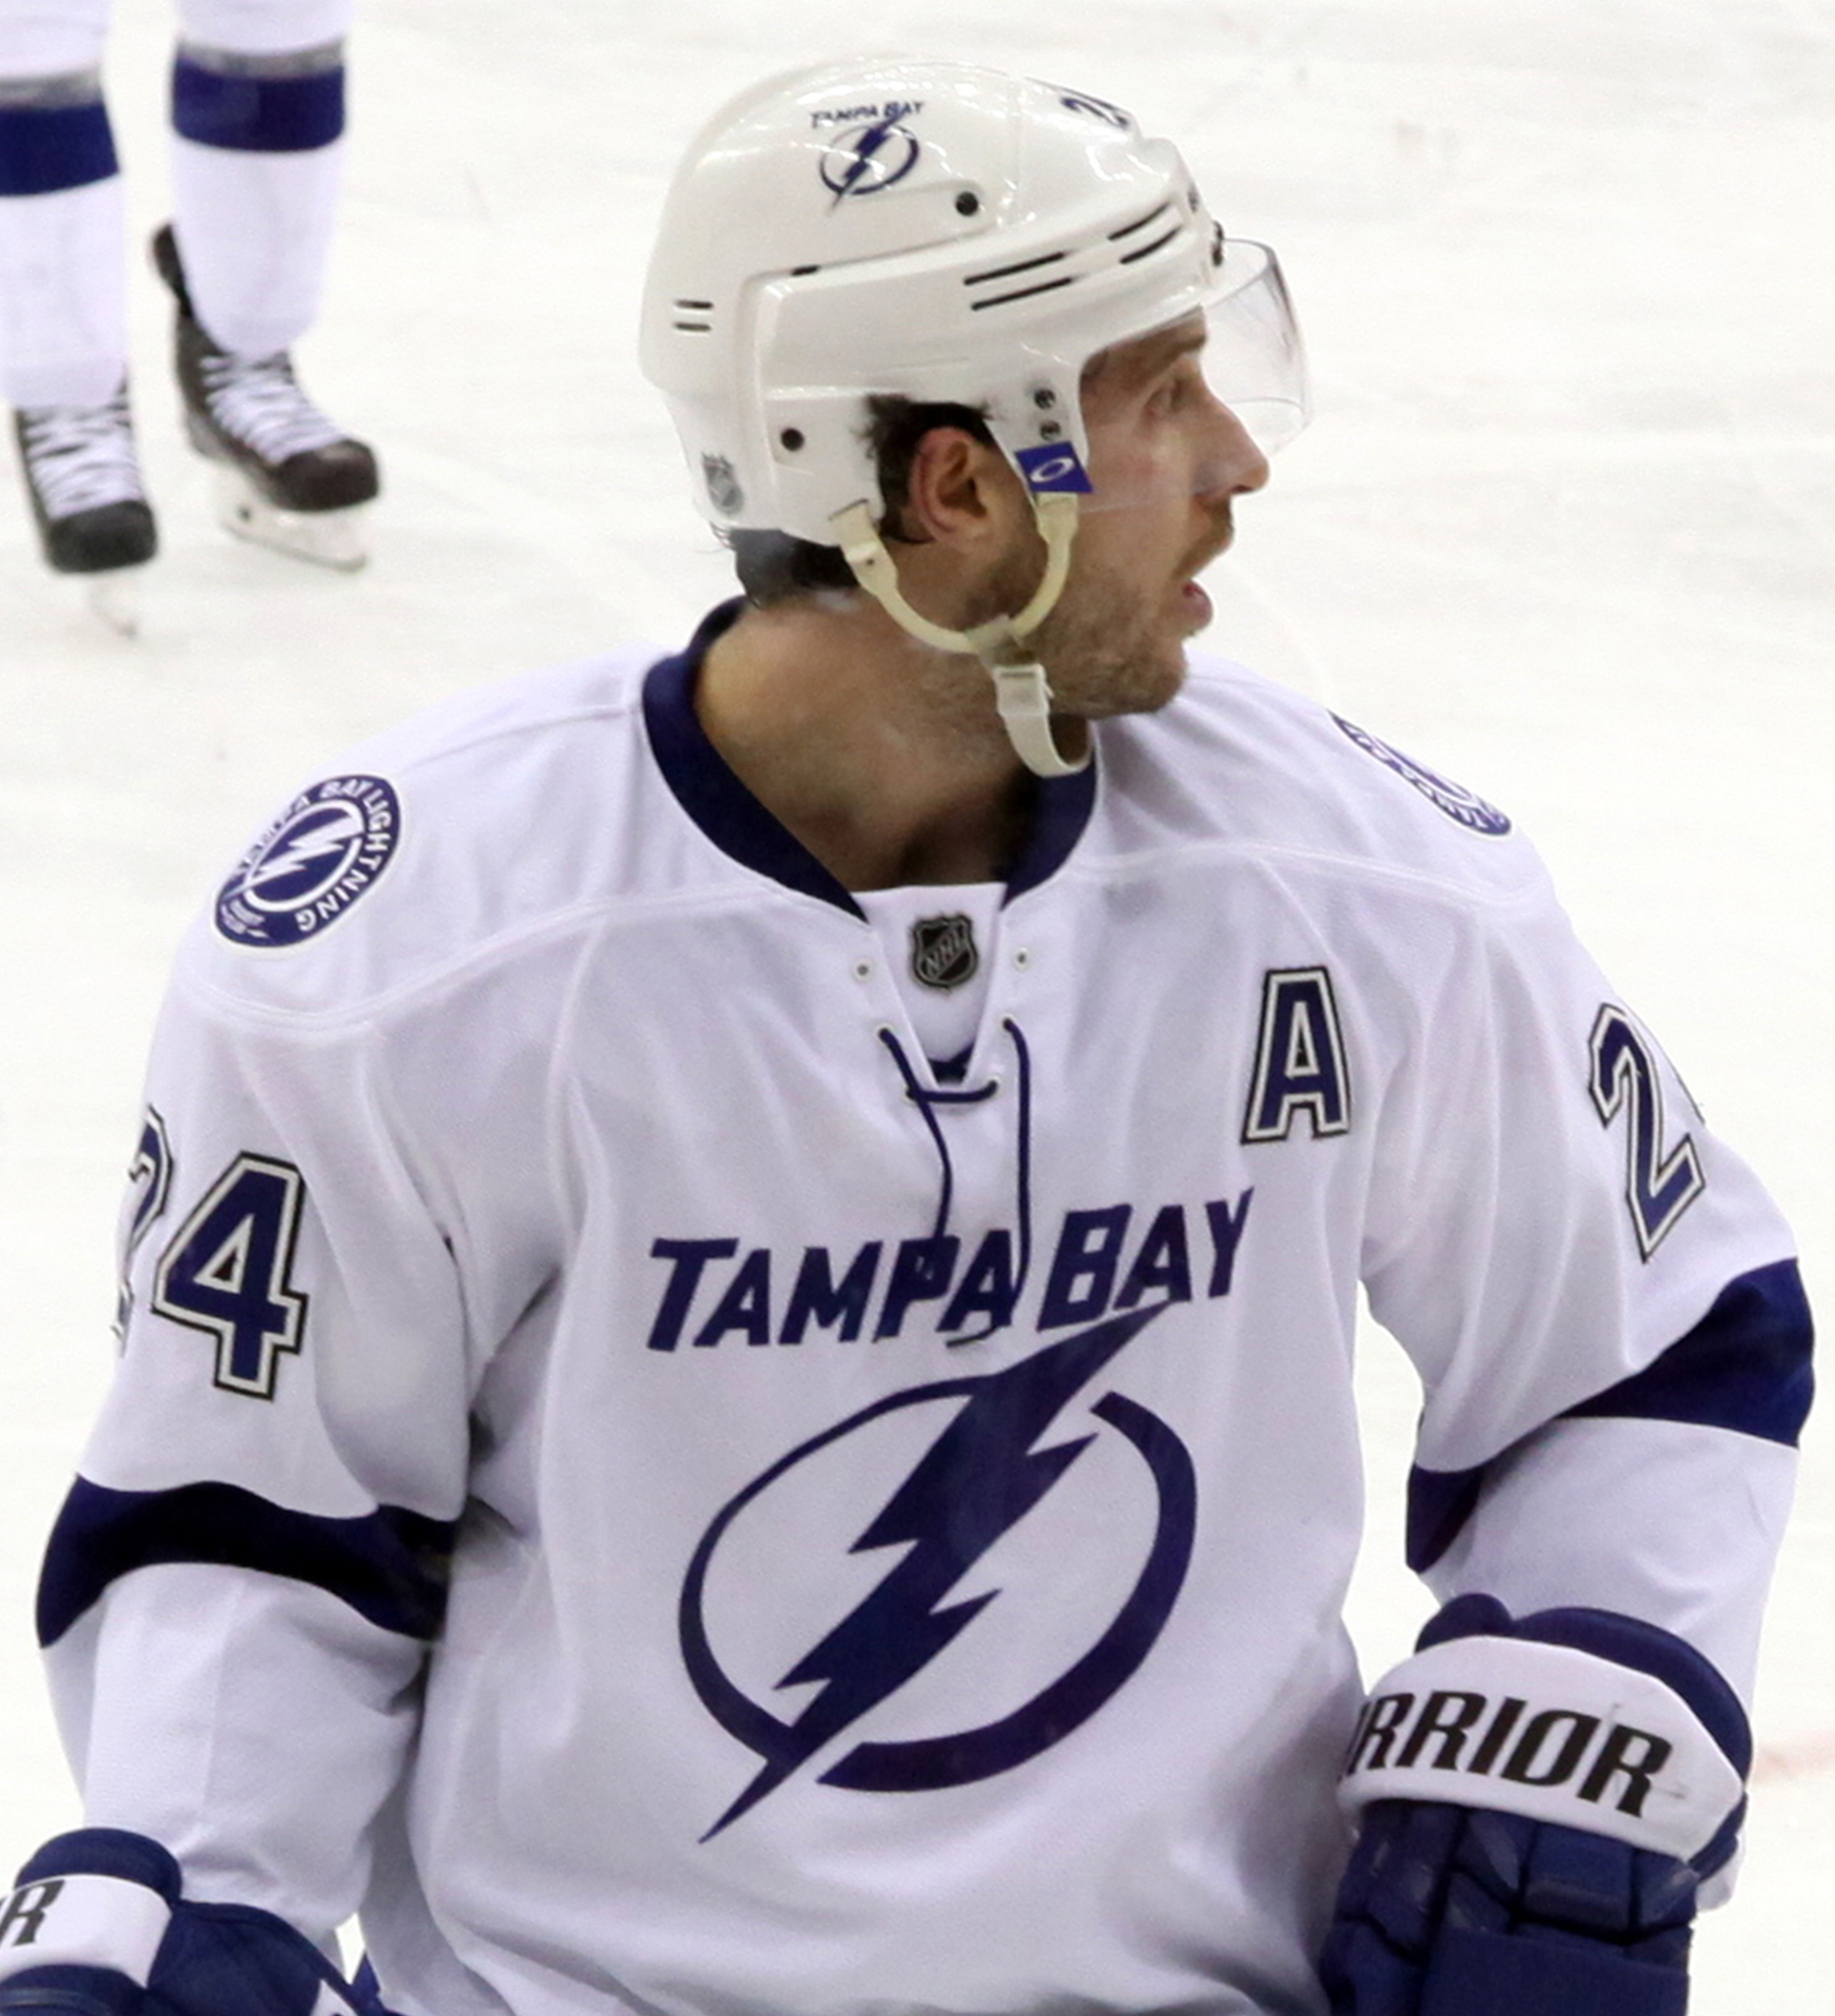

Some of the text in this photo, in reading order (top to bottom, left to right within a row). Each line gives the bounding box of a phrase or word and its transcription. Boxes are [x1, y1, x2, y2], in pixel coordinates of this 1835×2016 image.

[294, 788, 392, 931] LIGHTNING
[1240, 967, 1351, 1144] A
[647, 1187, 1253, 1353] TAMPA BAY
[1339, 1690, 1673, 1818] RRIOR
